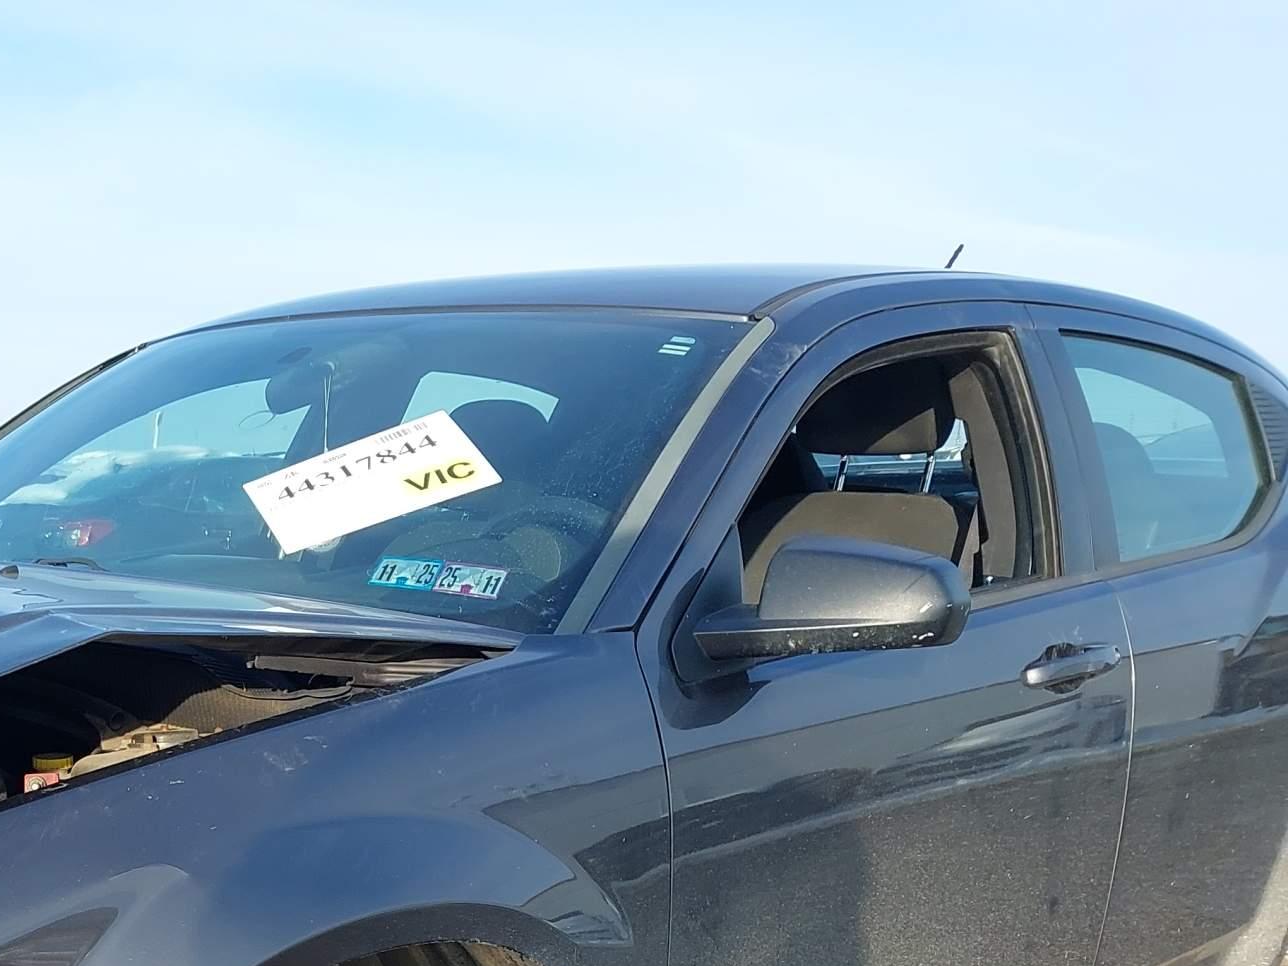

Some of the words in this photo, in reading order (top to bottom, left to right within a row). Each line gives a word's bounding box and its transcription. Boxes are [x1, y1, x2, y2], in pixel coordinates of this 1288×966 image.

[278, 434, 438, 501] 44317844
[403, 461, 476, 492] VIC
[416, 563, 439, 585] 25
[439, 566, 462, 588] 25
